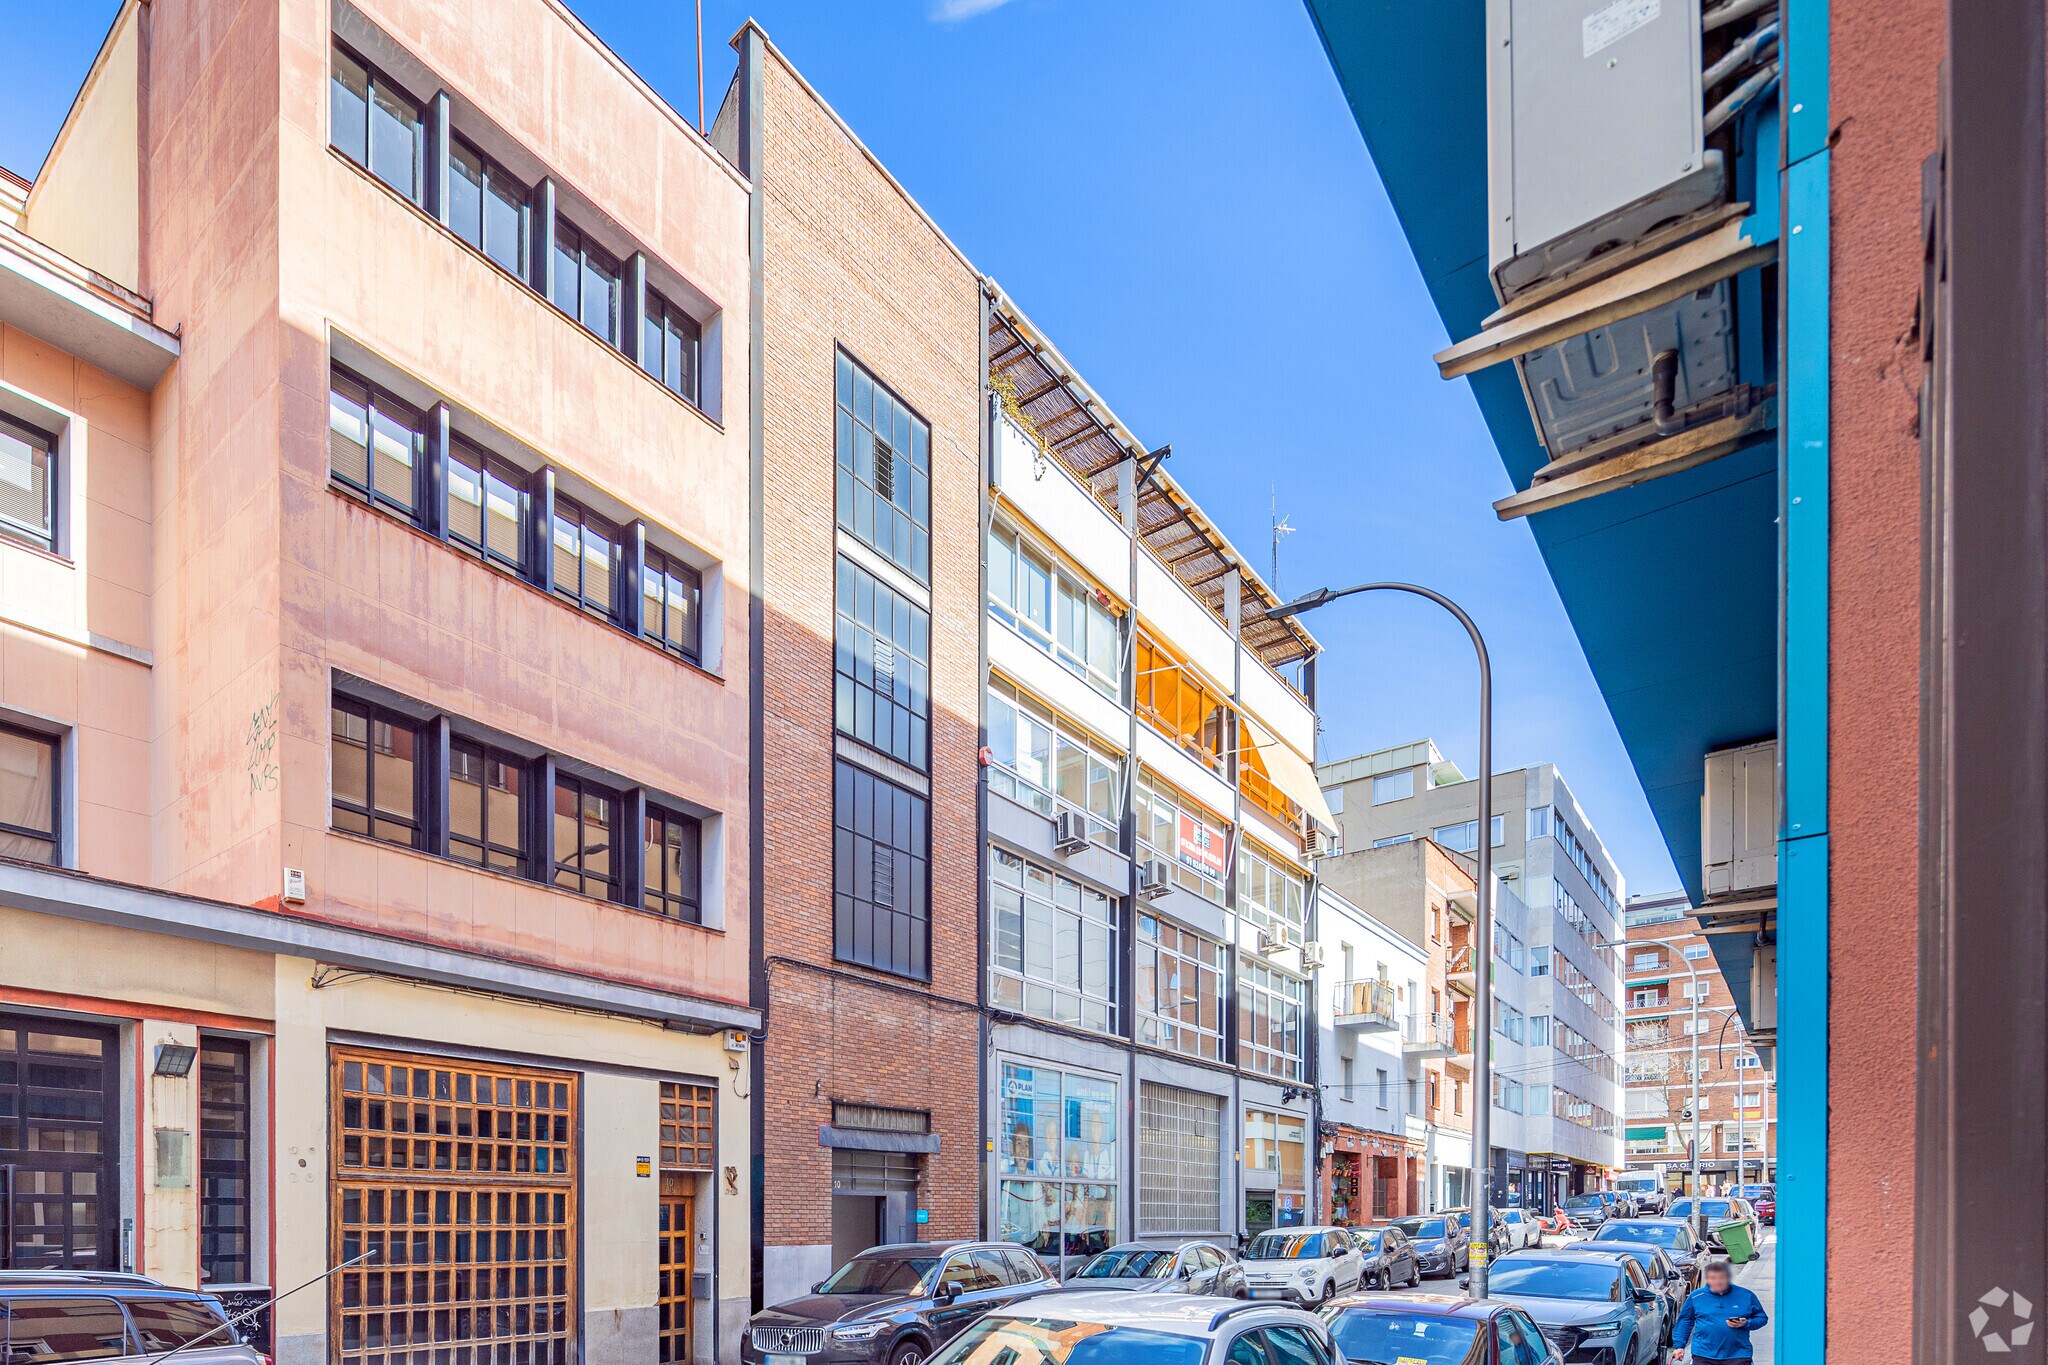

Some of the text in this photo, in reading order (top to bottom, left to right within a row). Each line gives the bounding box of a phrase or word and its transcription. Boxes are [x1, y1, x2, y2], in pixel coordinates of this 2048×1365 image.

[1018, 1083, 1032, 1092] PLAN
[666, 1177, 674, 1187] 10
[834, 1180, 841, 1189] 10
